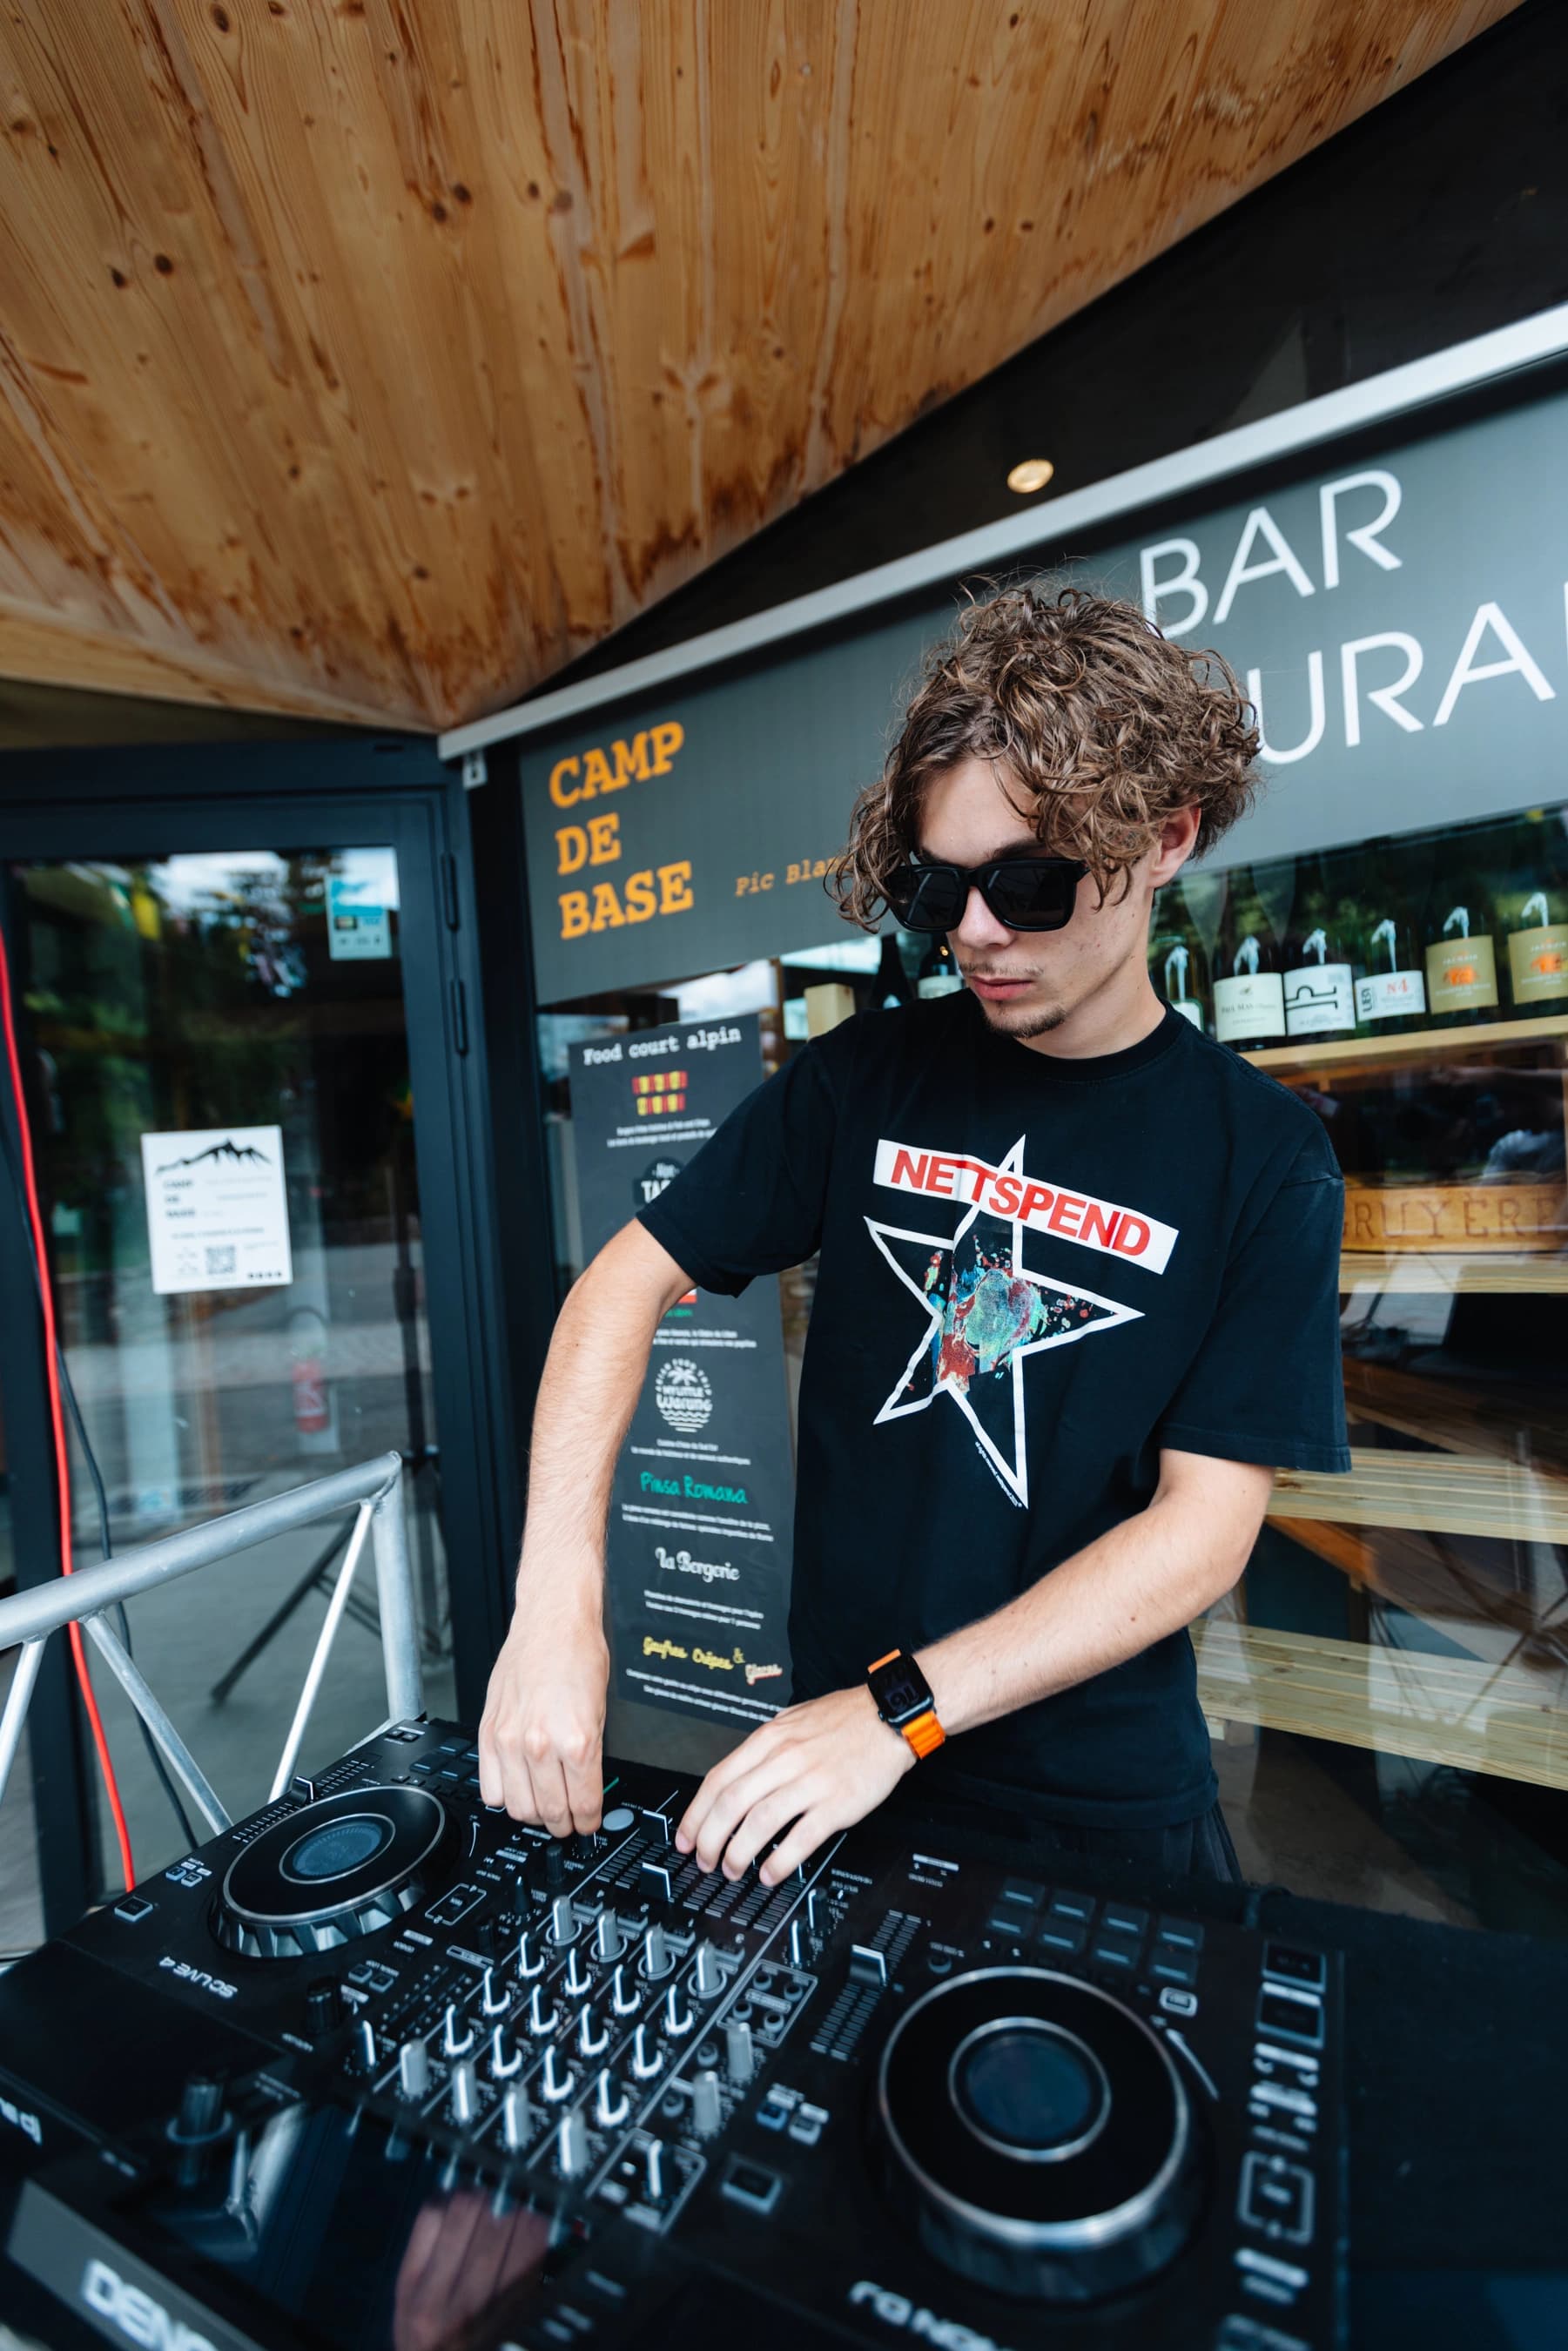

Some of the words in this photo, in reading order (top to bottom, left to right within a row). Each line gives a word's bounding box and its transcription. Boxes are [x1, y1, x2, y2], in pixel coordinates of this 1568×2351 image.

[1140, 469, 1403, 641] BAR
[1246, 581, 1568, 765] URA
[548, 721, 684, 808] CAMP
[555, 812, 622, 875] DE
[558, 860, 695, 940] BASE
[735, 871, 775, 897] Pic
[583, 1043, 622, 1066] Food
[629, 1035, 680, 1058] court
[687, 1026, 742, 1051] alpin
[891, 1149, 1152, 1256] NETSPEND
[1343, 1191, 1559, 1240] RUYÈRE
[640, 1471, 682, 1497] Pinsa
[683, 1475, 749, 1504] Romana
[676, 1551, 740, 1583] Bergerie
[82, 2257, 219, 2351] DEN
